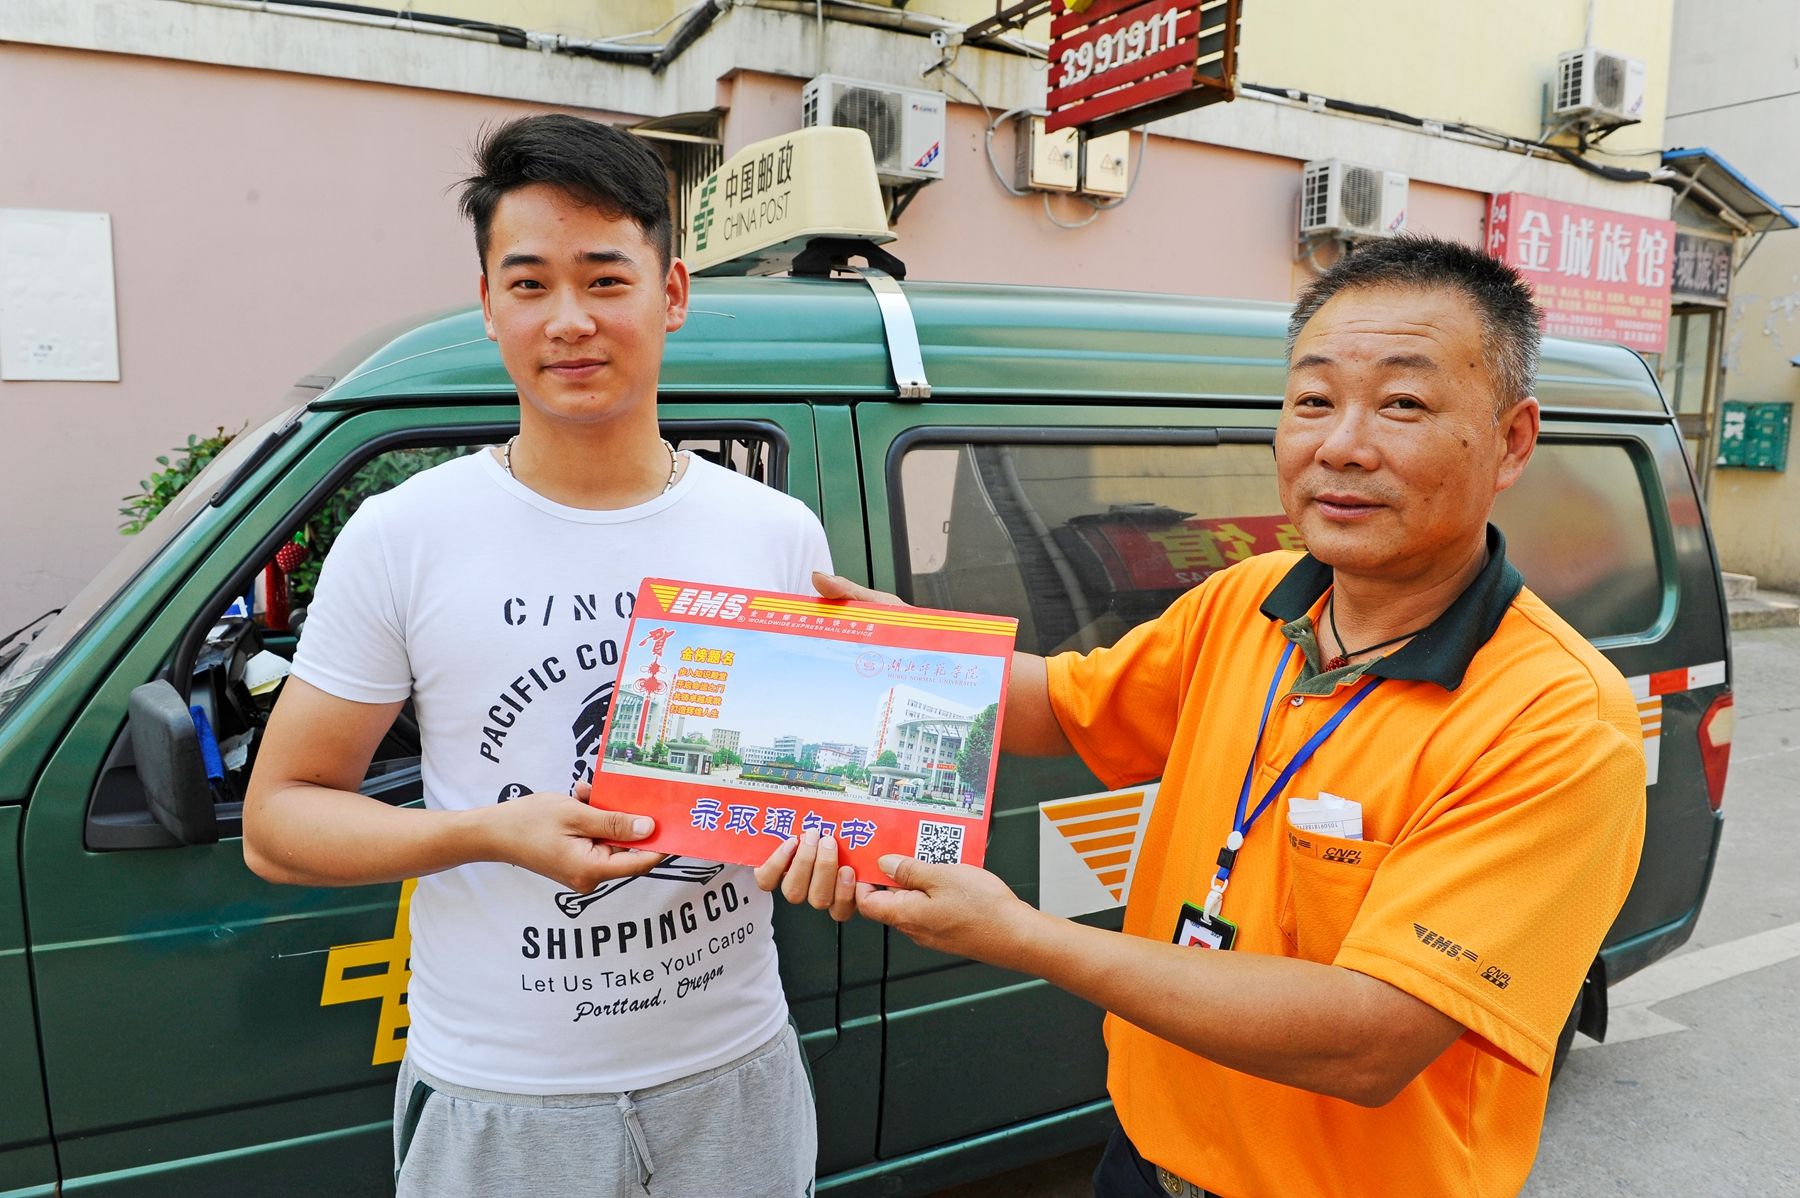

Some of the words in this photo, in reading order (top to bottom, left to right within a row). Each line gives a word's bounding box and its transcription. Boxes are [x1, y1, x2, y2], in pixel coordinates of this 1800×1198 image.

[1059, 7, 1178, 88] 3991911
[726, 140, 793, 208] 中国邮政
[724, 208, 757, 240] CHINA
[760, 191, 791, 228] POST
[1517, 209, 1668, 288] 金城旅馆
[669, 587, 748, 620] EMS
[749, 610, 875, 631] 全球邮政特快专递
[748, 617, 789, 627] WORLDWIDE
[791, 622, 823, 631] EXPRESS
[841, 629, 873, 637] SERVICE
[680, 646, 736, 667] 金榜题名
[909, 675, 935, 683] NORMAL
[480, 656, 566, 763] PACIFIC
[690, 798, 877, 849] 录取通知书
[1325, 847, 1362, 860] CNPL
[521, 902, 697, 959] SHIPPING
[703, 882, 749, 922] CO.
[521, 974, 555, 993] Let
[563, 975, 593, 992] Us
[600, 969, 654, 989] Take
[660, 948, 703, 975] Your
[708, 922, 754, 954] Cargo
[1422, 931, 1463, 958] EMS
[677, 965, 725, 999] Oregon
[1486, 965, 1512, 984] CNPL
